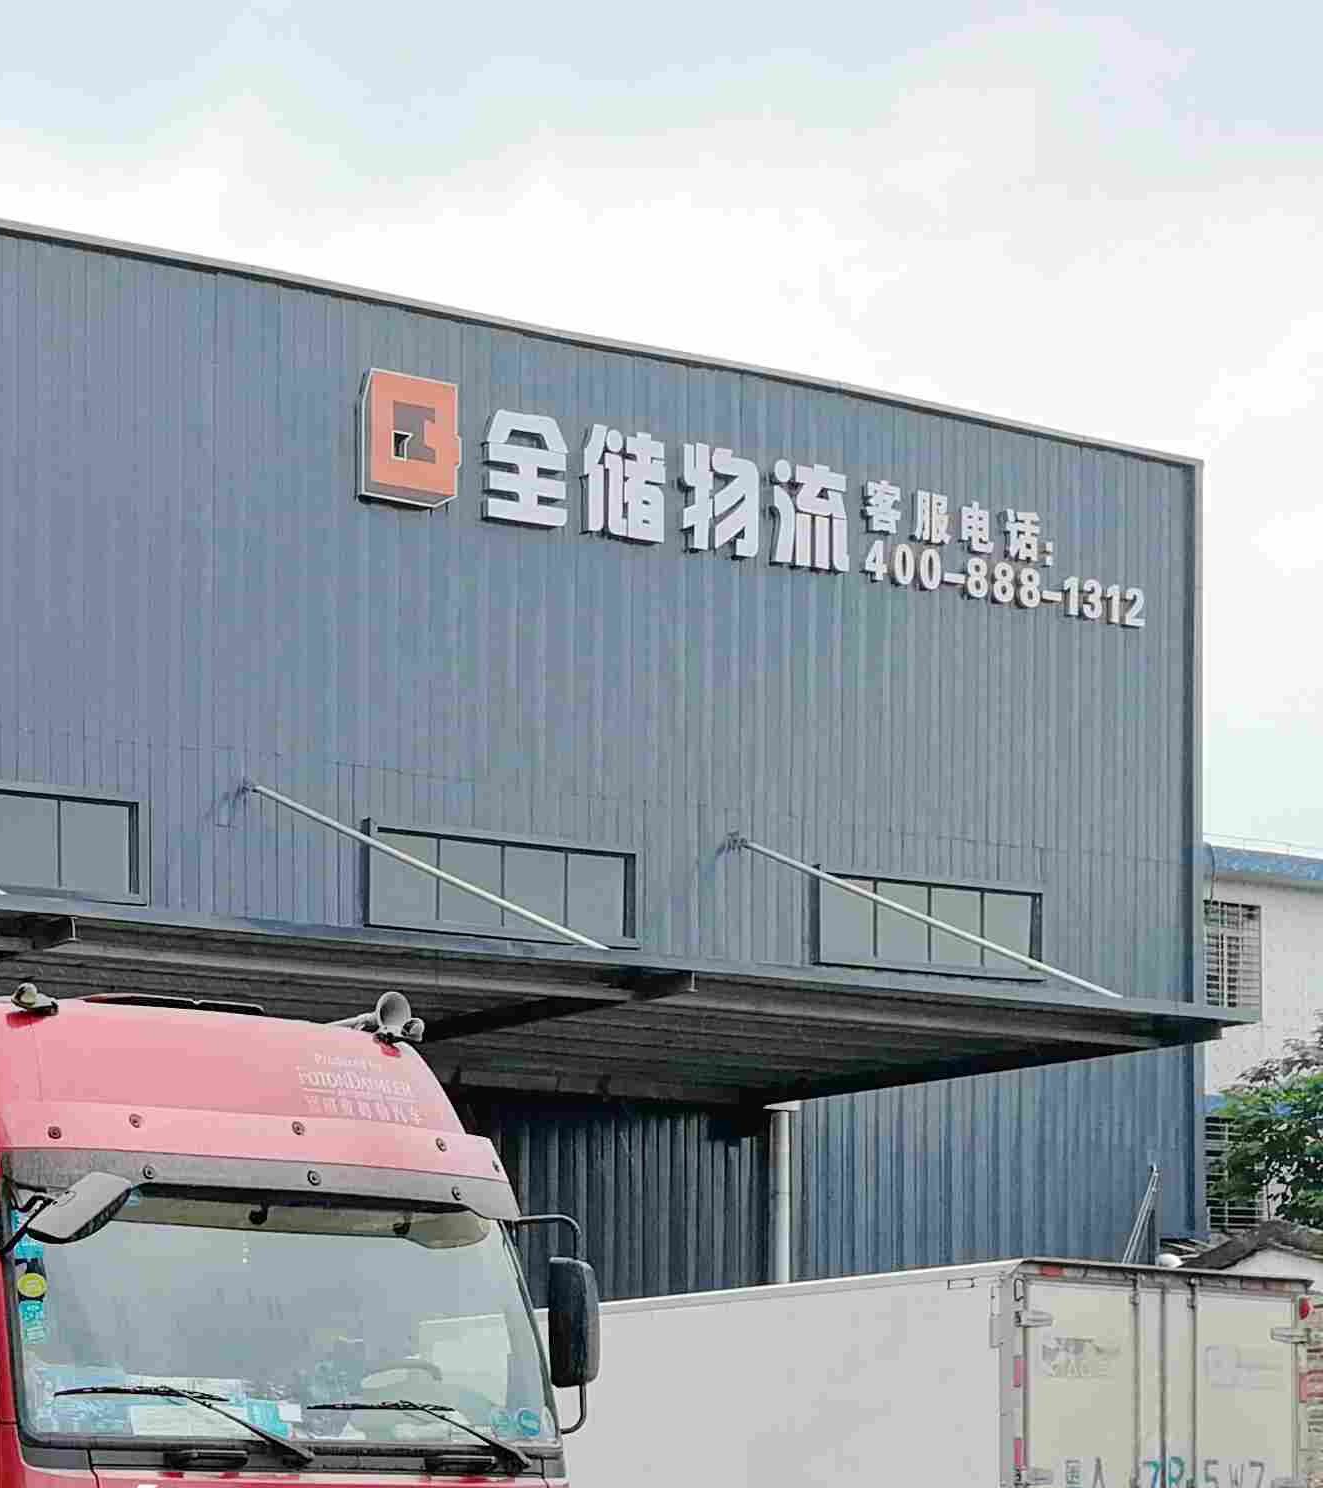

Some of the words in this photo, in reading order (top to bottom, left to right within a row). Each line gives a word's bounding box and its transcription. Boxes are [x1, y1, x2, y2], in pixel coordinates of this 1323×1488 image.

[482, 408, 851, 573] 全储物流
[863, 539, 1146, 628] 400-888-1312
